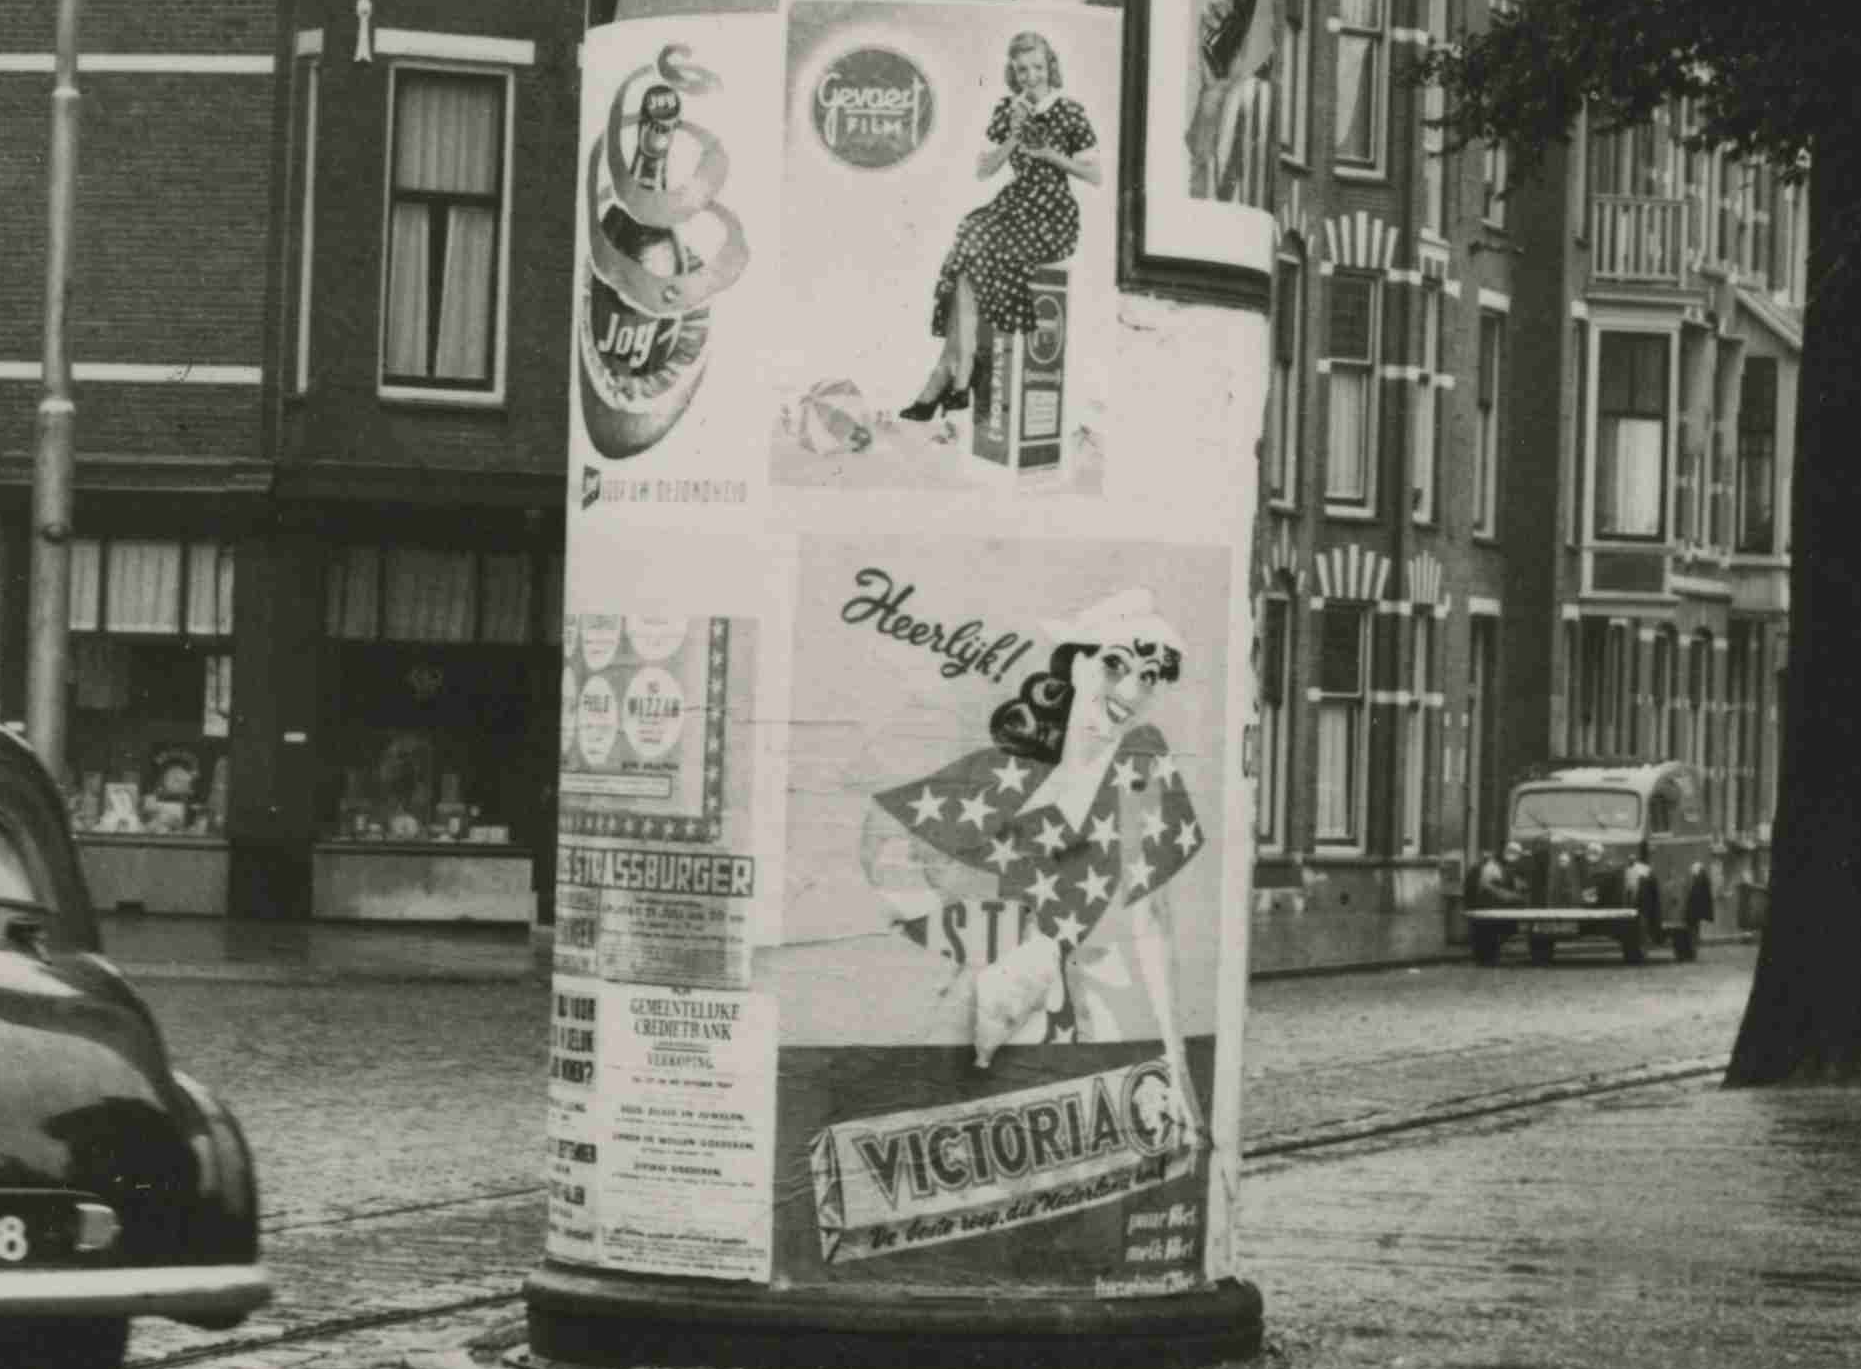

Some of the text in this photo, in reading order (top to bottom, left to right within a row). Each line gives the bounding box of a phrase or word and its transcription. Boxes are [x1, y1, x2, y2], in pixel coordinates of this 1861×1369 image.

[818, 72, 926, 148] Gevaert
[845, 116, 904, 135] FILM
[841, 567, 1035, 683] Heerlijk!
[628, 996, 742, 1022] GEMEENTELIJKE
[850, 1074, 1128, 1212] VICTORIA
